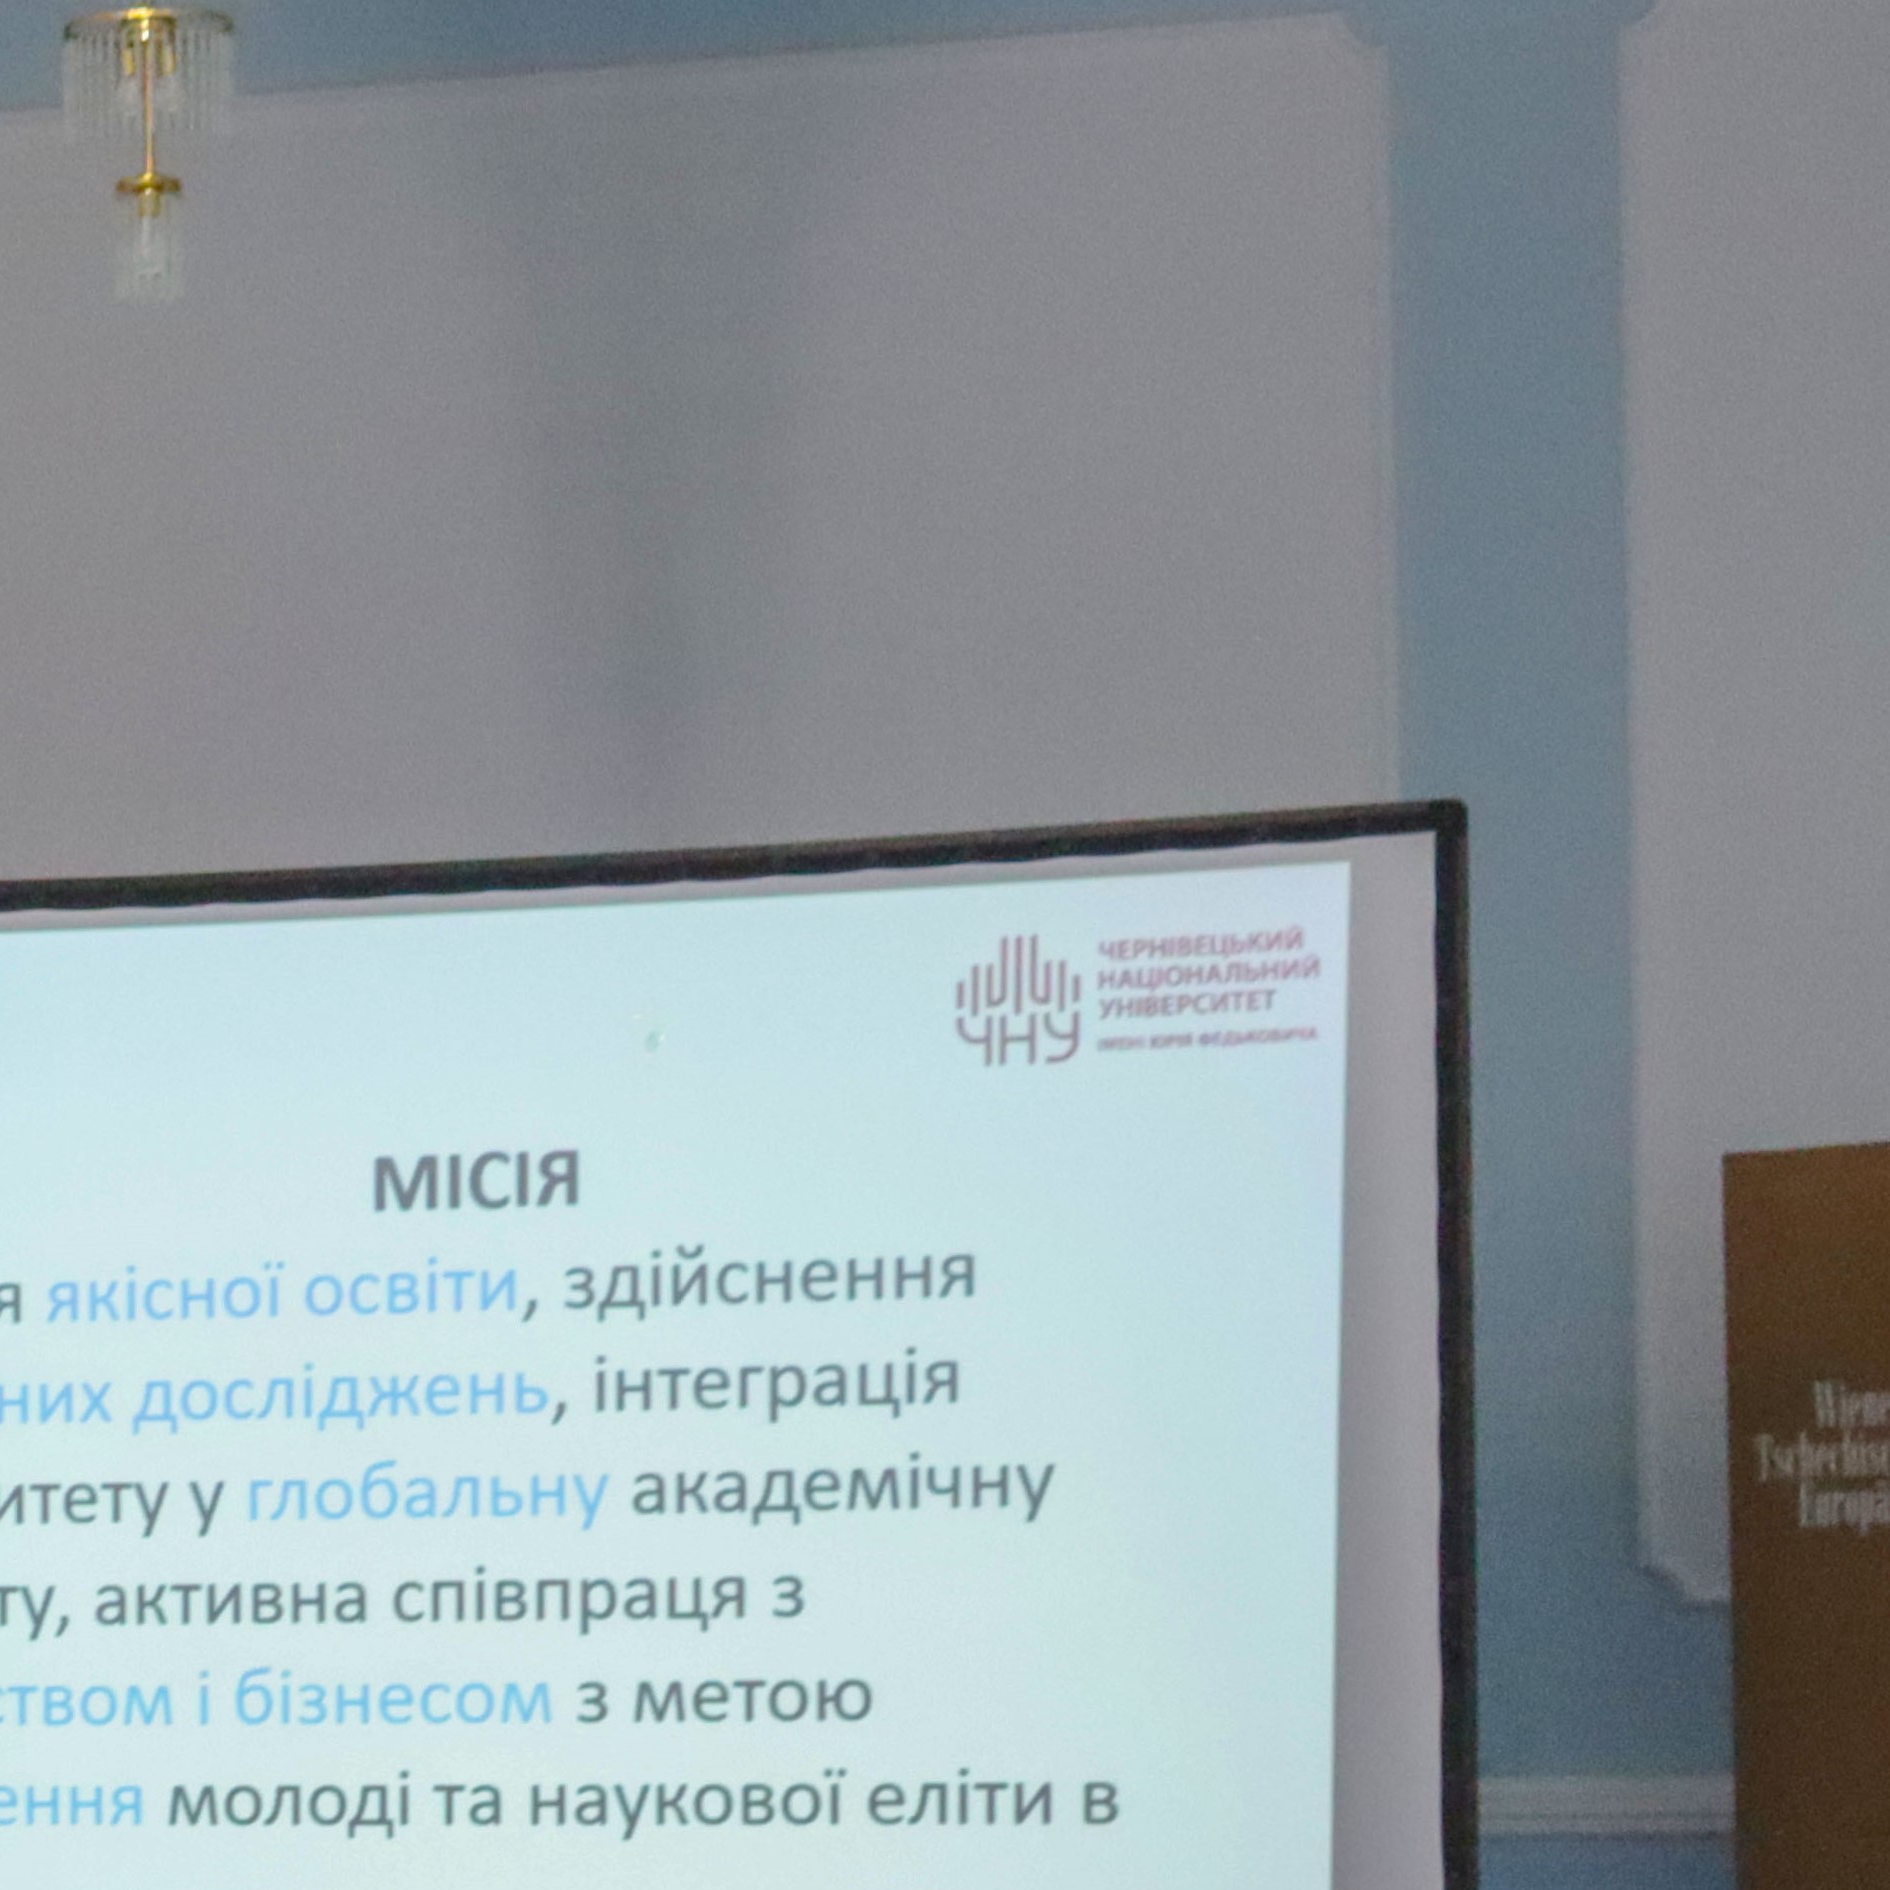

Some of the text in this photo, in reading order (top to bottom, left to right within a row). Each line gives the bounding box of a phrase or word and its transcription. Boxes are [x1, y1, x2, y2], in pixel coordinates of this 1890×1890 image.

[1098, 926, 1305, 961] ЧЕРНІВЕЦЬКИЙ
[1098, 953, 1321, 990] НАЦІОНАЛЬНИЙ
[1099, 989, 1277, 1020] УНІВЕРСИТЕТ
[955, 1010, 1082, 1067] ЧНУ
[374, 1150, 579, 1212] МІСІЯ
[47, 1261, 285, 1323] якісної
[304, 1256, 538, 1323] освіти,
[565, 1242, 975, 1319] здійснення
[132, 1363, 567, 1433] досліджень,
[596, 1345, 959, 1424] інтеграція
[189, 1481, 224, 1537] у
[249, 1457, 609, 1532] глобальну
[632, 1451, 1055, 1527] академічну
[95, 1582, 367, 1626] активна
[393, 1565, 746, 1635] співпраця
[773, 1575, 805, 1618] з
[199, 1669, 210, 1725] і
[235, 1666, 552, 1726] бізнесом
[577, 1681, 608, 1725] з
[634, 1679, 872, 1723] метою
[168, 1769, 409, 1839] молоді
[433, 1784, 502, 1826] та
[530, 1766, 847, 1841] наукової
[868, 1768, 1052, 1826] еліти
[1083, 1782, 1119, 1825] в
